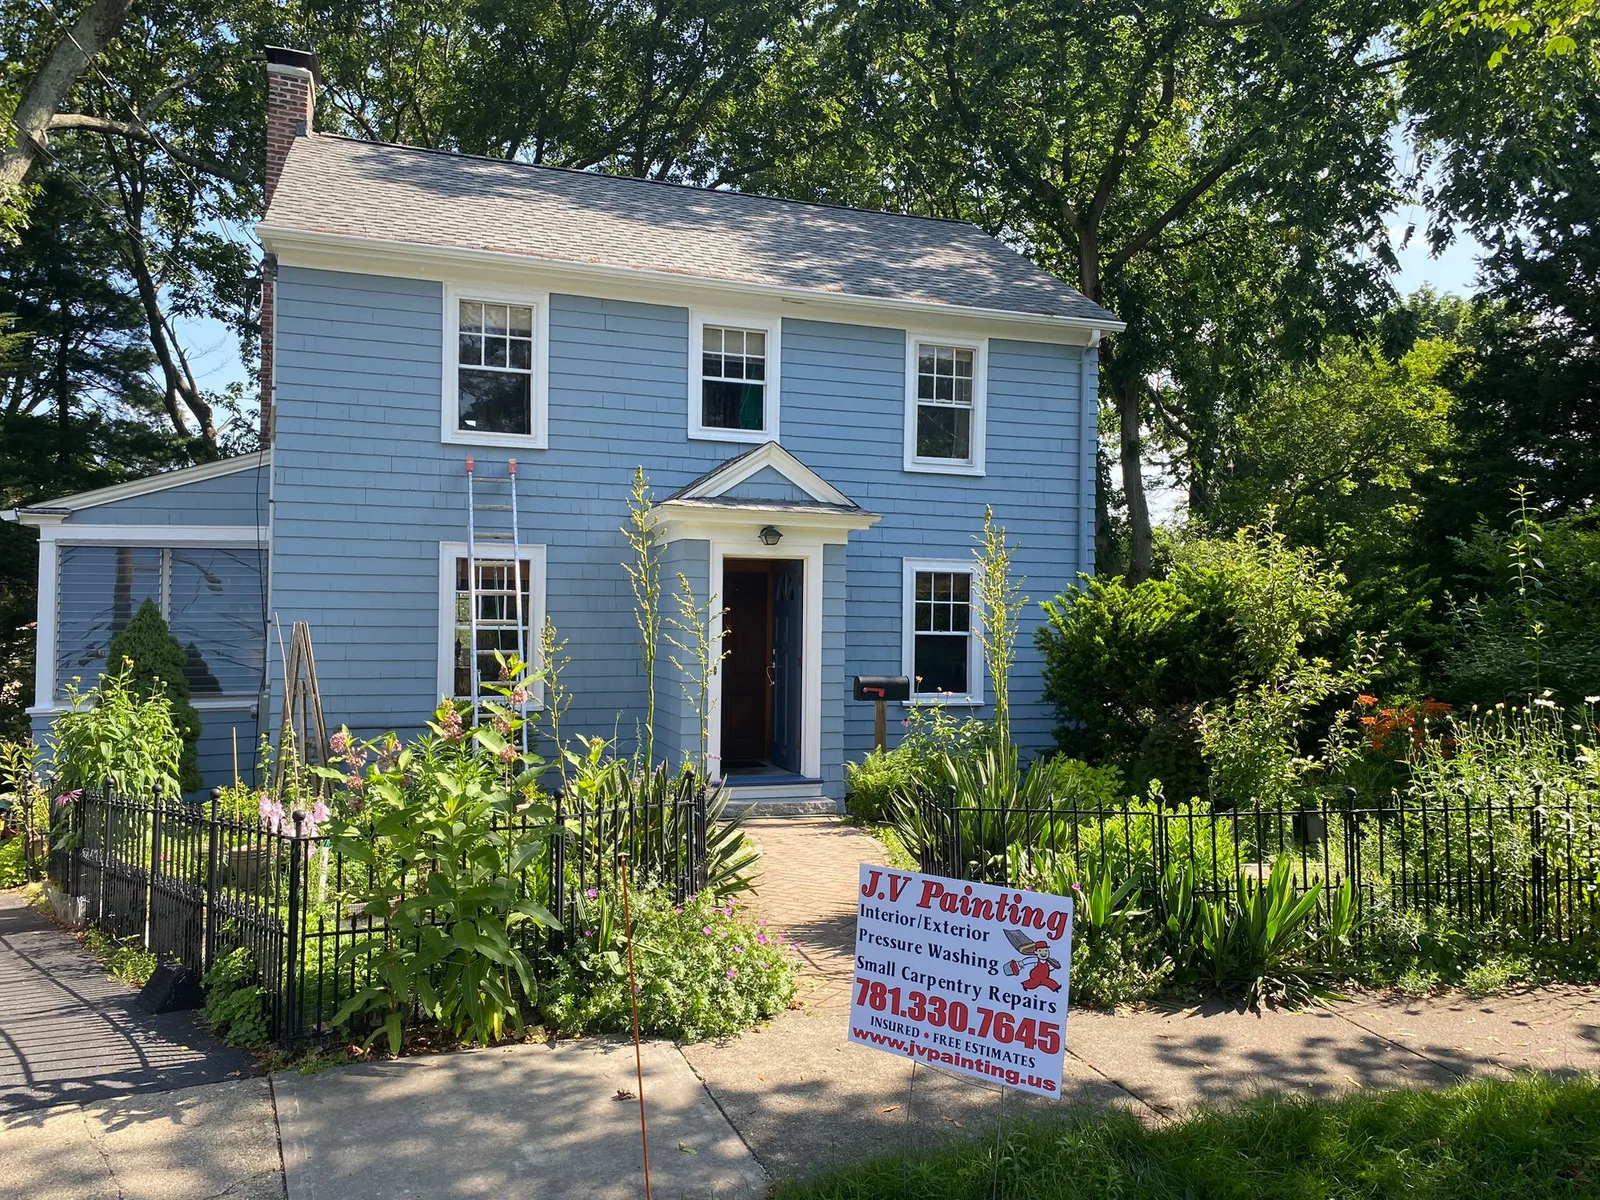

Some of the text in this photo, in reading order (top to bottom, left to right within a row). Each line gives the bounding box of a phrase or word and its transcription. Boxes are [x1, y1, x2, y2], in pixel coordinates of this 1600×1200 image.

[860, 903, 990, 942] Interior/Exterior
[861, 870, 1069, 941] J.V Painting
[859, 928, 999, 976] Pressure Washing
[856, 955, 1057, 1014] Small Carpentry Repairs
[856, 978, 1061, 1055] 781.330.7645
[870, 1016, 1036, 1068] INSURED FREE ESTIMATES
[852, 1026, 1057, 1092] www.jvpainting.us
